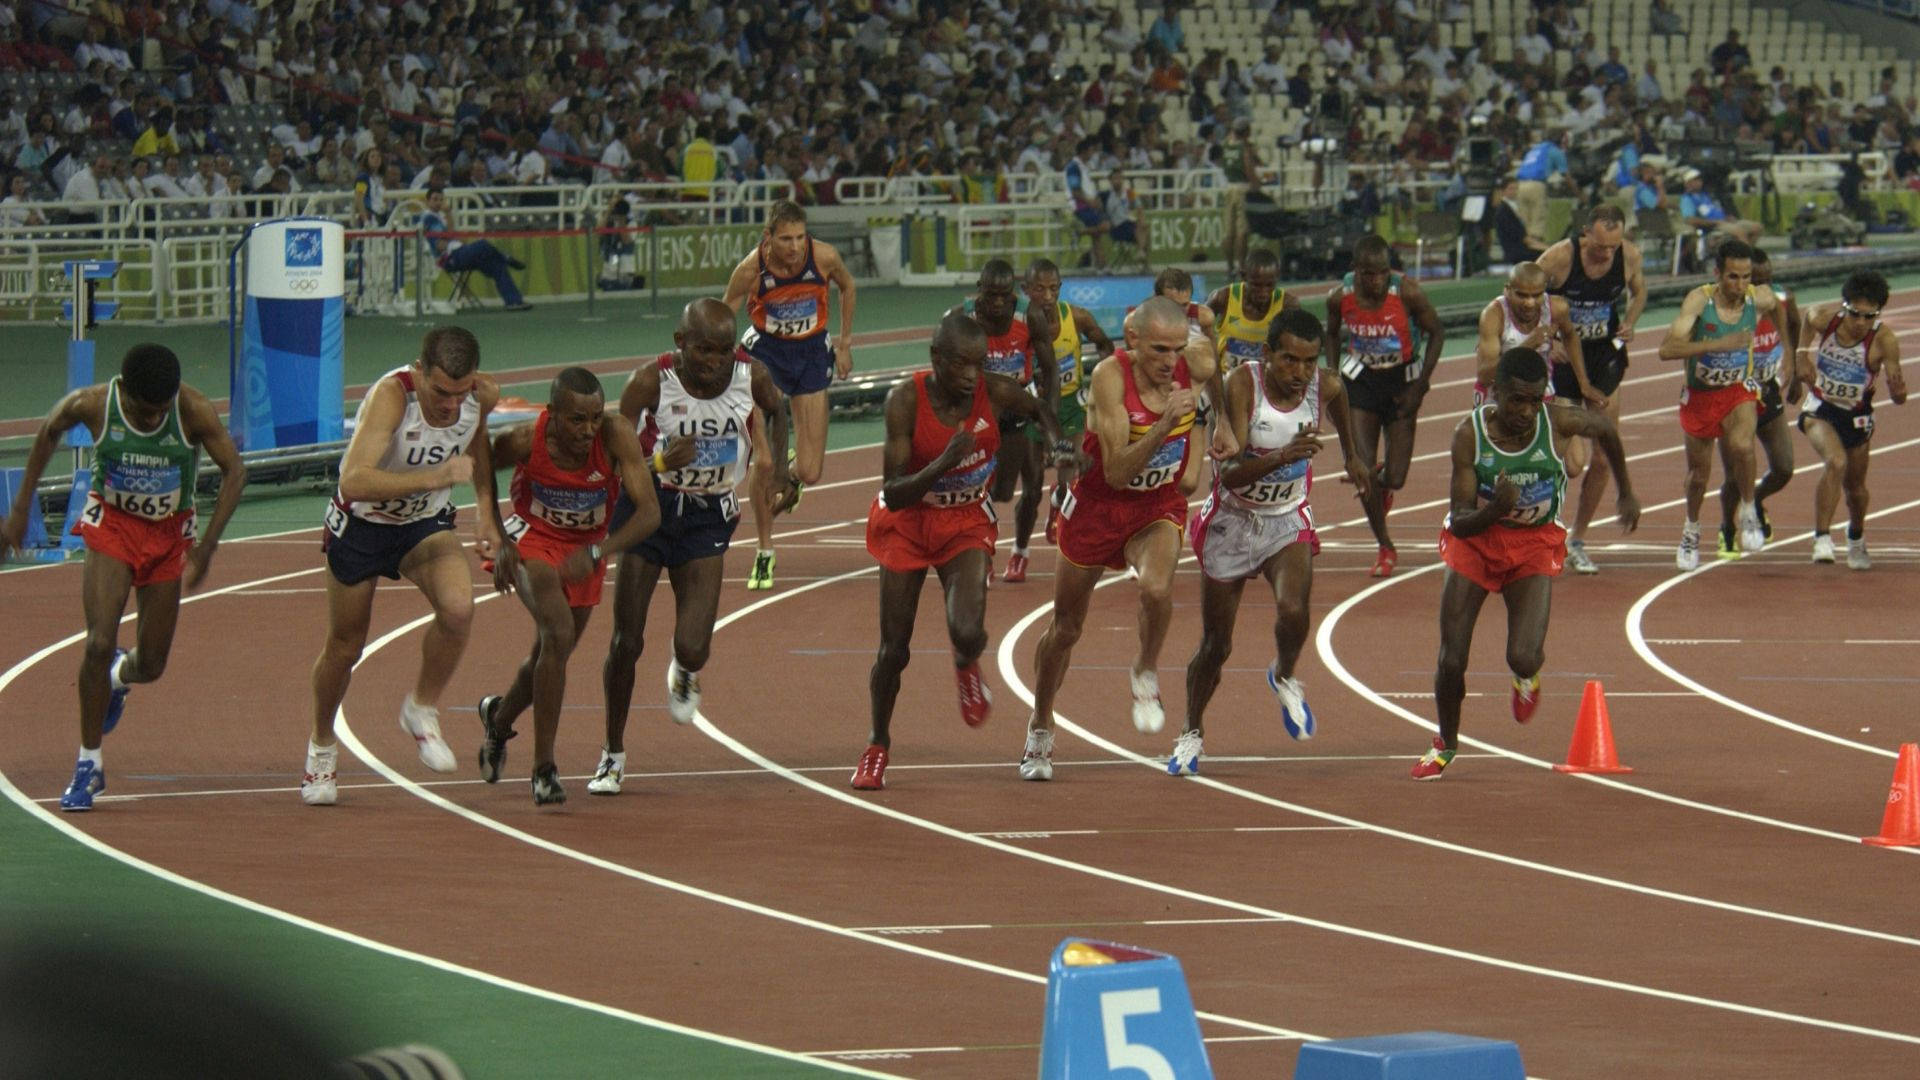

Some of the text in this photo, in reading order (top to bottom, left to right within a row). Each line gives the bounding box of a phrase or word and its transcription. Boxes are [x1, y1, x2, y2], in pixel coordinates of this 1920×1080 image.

[1151, 215, 1223, 250] ENS 200
[635, 232, 744, 271] THENS 2004
[772, 319, 811, 335] 2571
[1349, 323, 1397, 337] KENYA
[1753, 331, 1778, 348] ENY
[680, 417, 738, 437] USA
[122, 452, 169, 467] ETHIOPIA
[406, 445, 461, 466] USA
[671, 466, 725, 488] 3221
[1240, 482, 1295, 502] 2514
[114, 494, 172, 516] 1665
[540, 509, 595, 528] 1554
[1100, 988, 1176, 1080] 5
